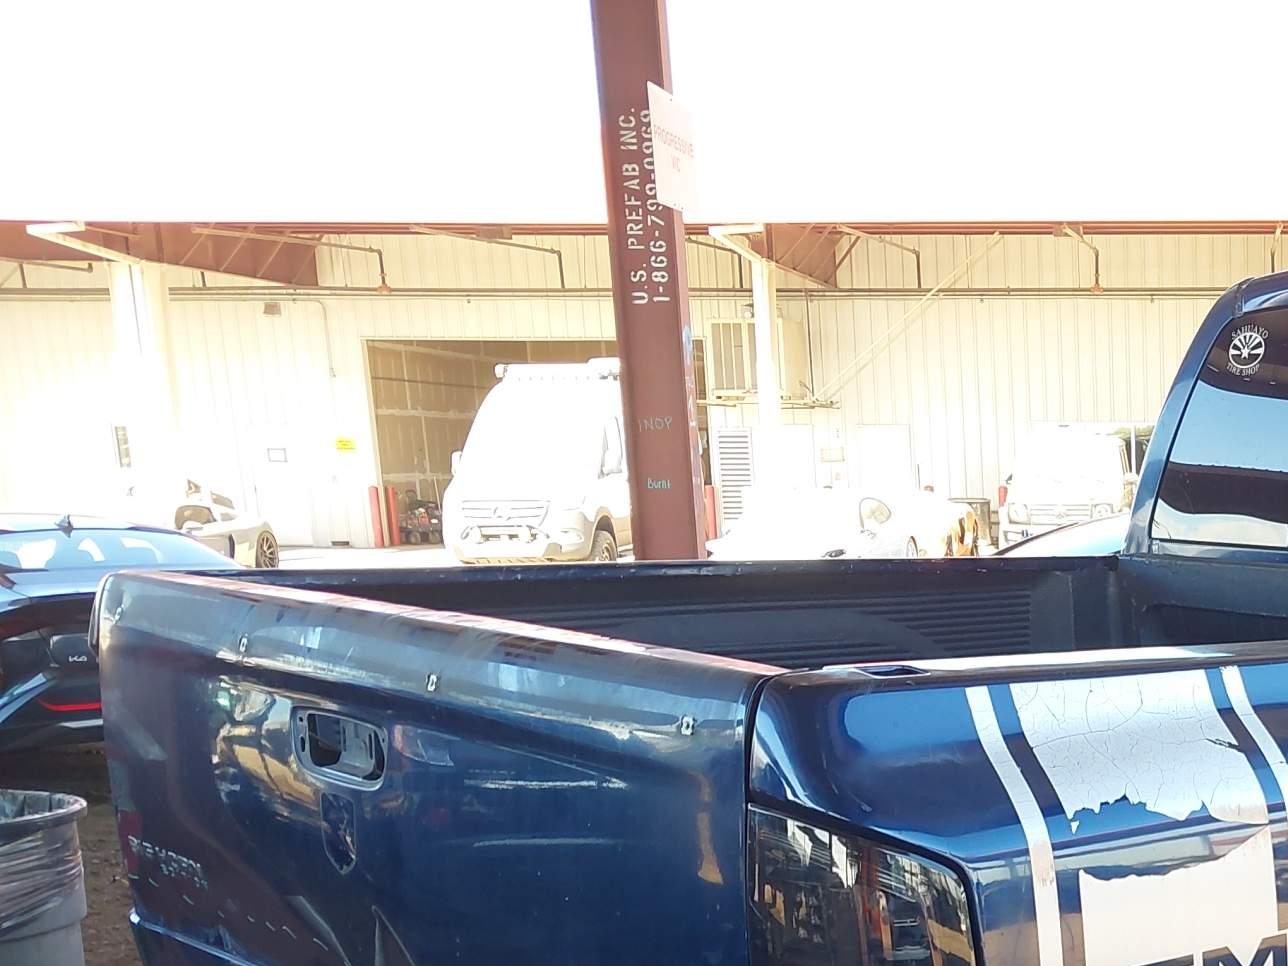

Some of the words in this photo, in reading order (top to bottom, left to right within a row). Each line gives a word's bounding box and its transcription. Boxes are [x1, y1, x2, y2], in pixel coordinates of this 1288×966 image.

[618, 107, 638, 150] INC.
[622, 163, 646, 250] PREFAB
[630, 263, 649, 305] U.S.
[1231, 324, 1269, 341] SAHUAYO
[1226, 361, 1241, 376] TIRE
[1241, 363, 1260, 377] SHOP
